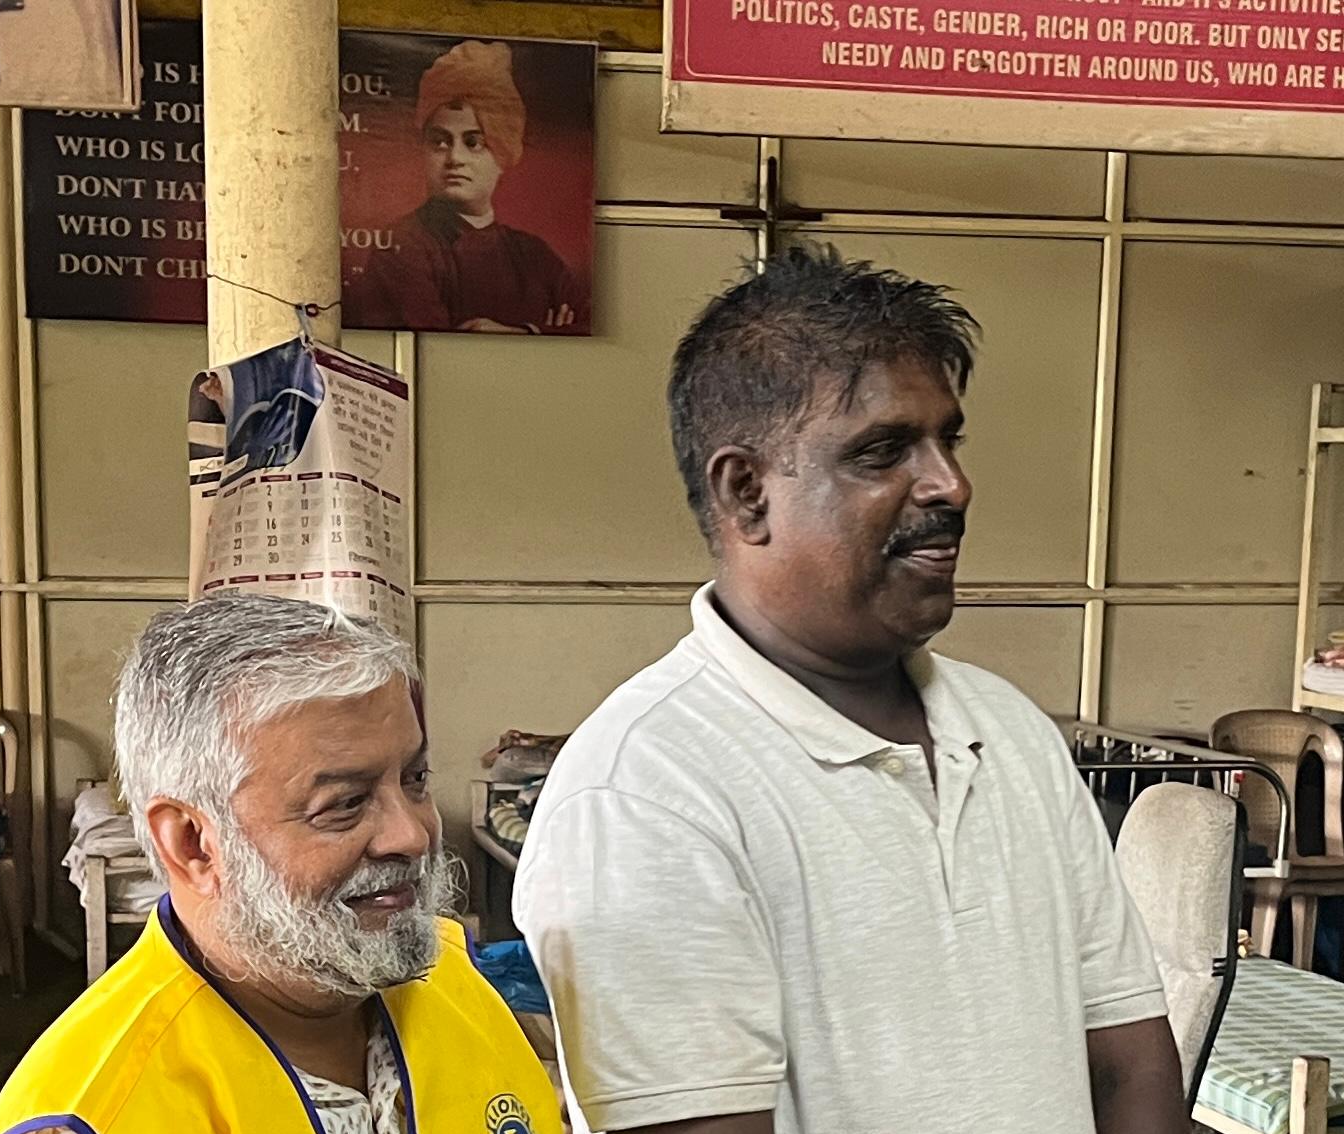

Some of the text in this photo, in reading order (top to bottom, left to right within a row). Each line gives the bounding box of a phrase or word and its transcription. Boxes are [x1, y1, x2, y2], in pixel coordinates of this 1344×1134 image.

[731, 0, 840, 31] POLITICS,
[848, 5, 926, 35] CASTE,
[933, 9, 1028, 41] GENDER,
[1036, 14, 1088, 41] RICH
[1097, 18, 1126, 42] OR
[1134, 20, 1201, 46] POOR.
[1208, 23, 1251, 48] BUT
[1257, 26, 1311, 50] ONLY
[153, 62, 181, 83] IS
[822, 41, 894, 67] NEEDY
[899, 46, 945, 70] AND
[953, 48, 1081, 77] FORGOTTEN
[1088, 56, 1178, 82] AROUND
[1185, 59, 1220, 88] US,
[1227, 61, 1277, 87] WHO
[1284, 64, 1326, 88] ARE
[55, 135, 130, 159] WHO
[140, 140, 165, 161] IS
[56, 174, 146, 199] DON'T
[57, 214, 131, 237] WHO
[141, 218, 166, 240] IS
[59, 253, 148, 277] DON'T
[266, 518, 277, 529] 16
[267, 535, 277, 547] 23
[331, 532, 342, 543] 25
